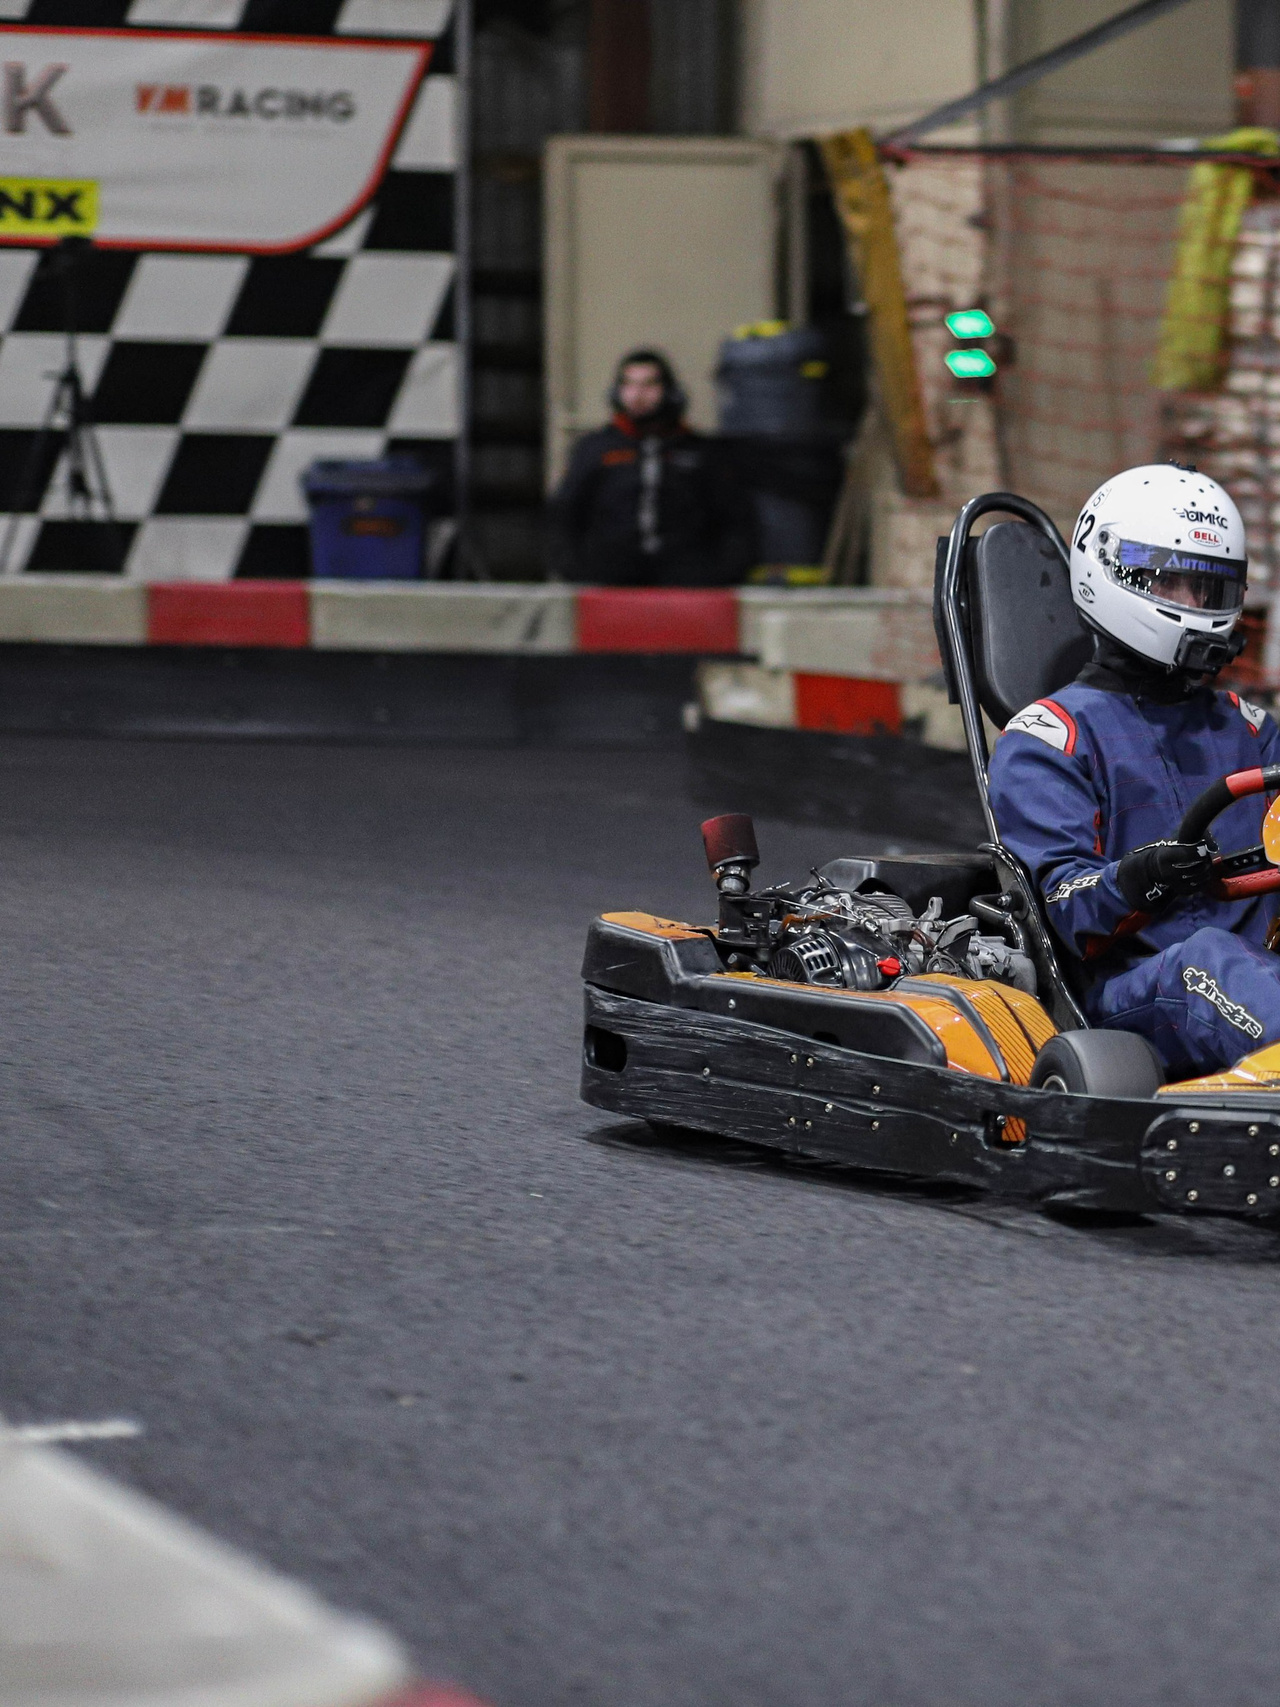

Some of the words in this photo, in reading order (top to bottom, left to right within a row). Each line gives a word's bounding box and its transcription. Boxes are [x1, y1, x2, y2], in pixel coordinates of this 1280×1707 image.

[198, 85, 356, 124] RACING
[1073, 509, 1096, 554] 12
[1194, 530, 1219, 543] BELL
